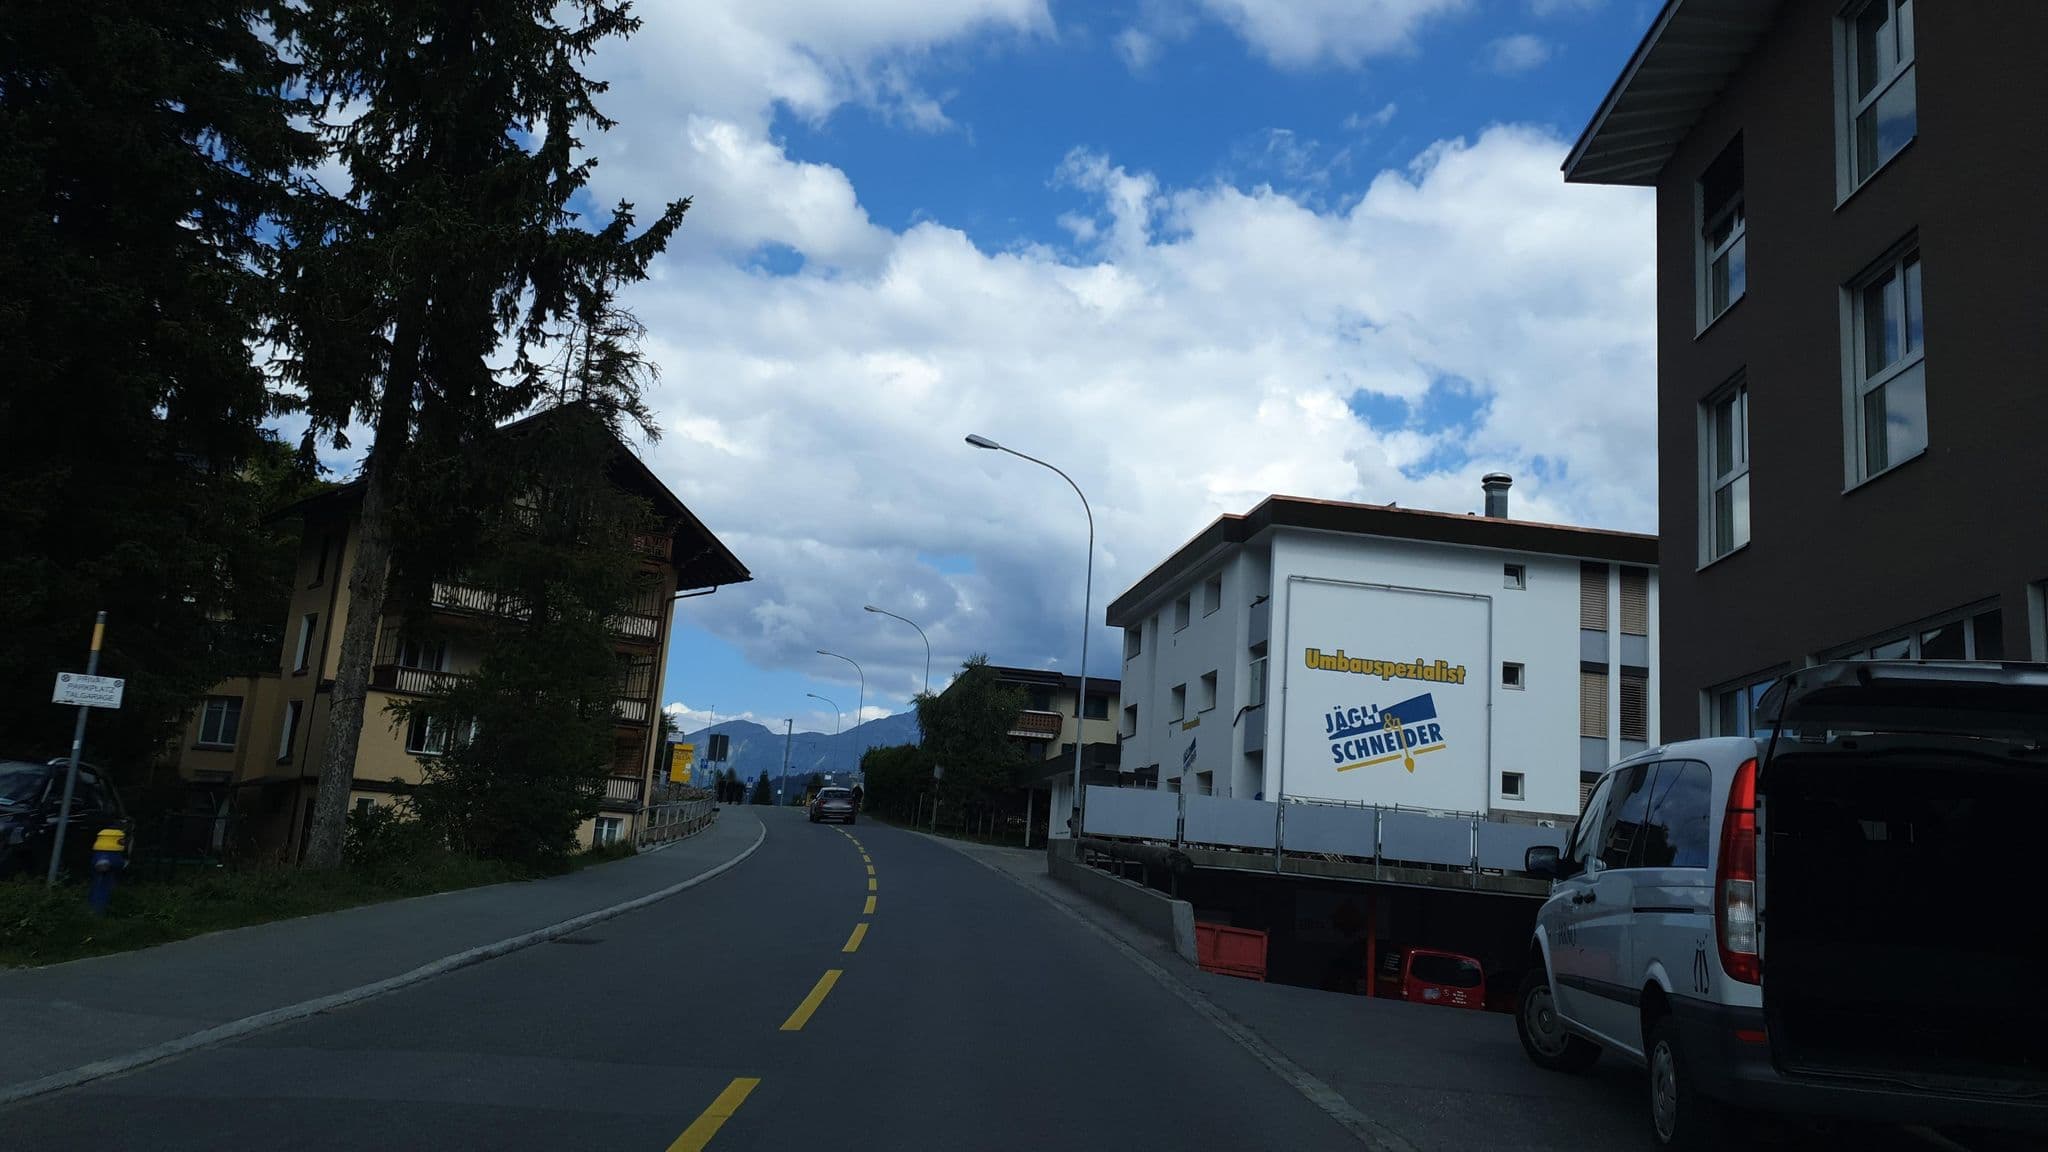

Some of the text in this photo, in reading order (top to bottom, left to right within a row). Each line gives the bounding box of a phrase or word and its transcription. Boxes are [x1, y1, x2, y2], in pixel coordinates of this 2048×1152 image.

[1305, 648, 1466, 684] Umbauspezialist
[65, 690, 115, 702] TALGARAGE
[66, 682, 116, 693] PARKPLATZ
[1325, 704, 1382, 734] JÄGLI
[1331, 722, 1444, 763] SCHNEIDER
